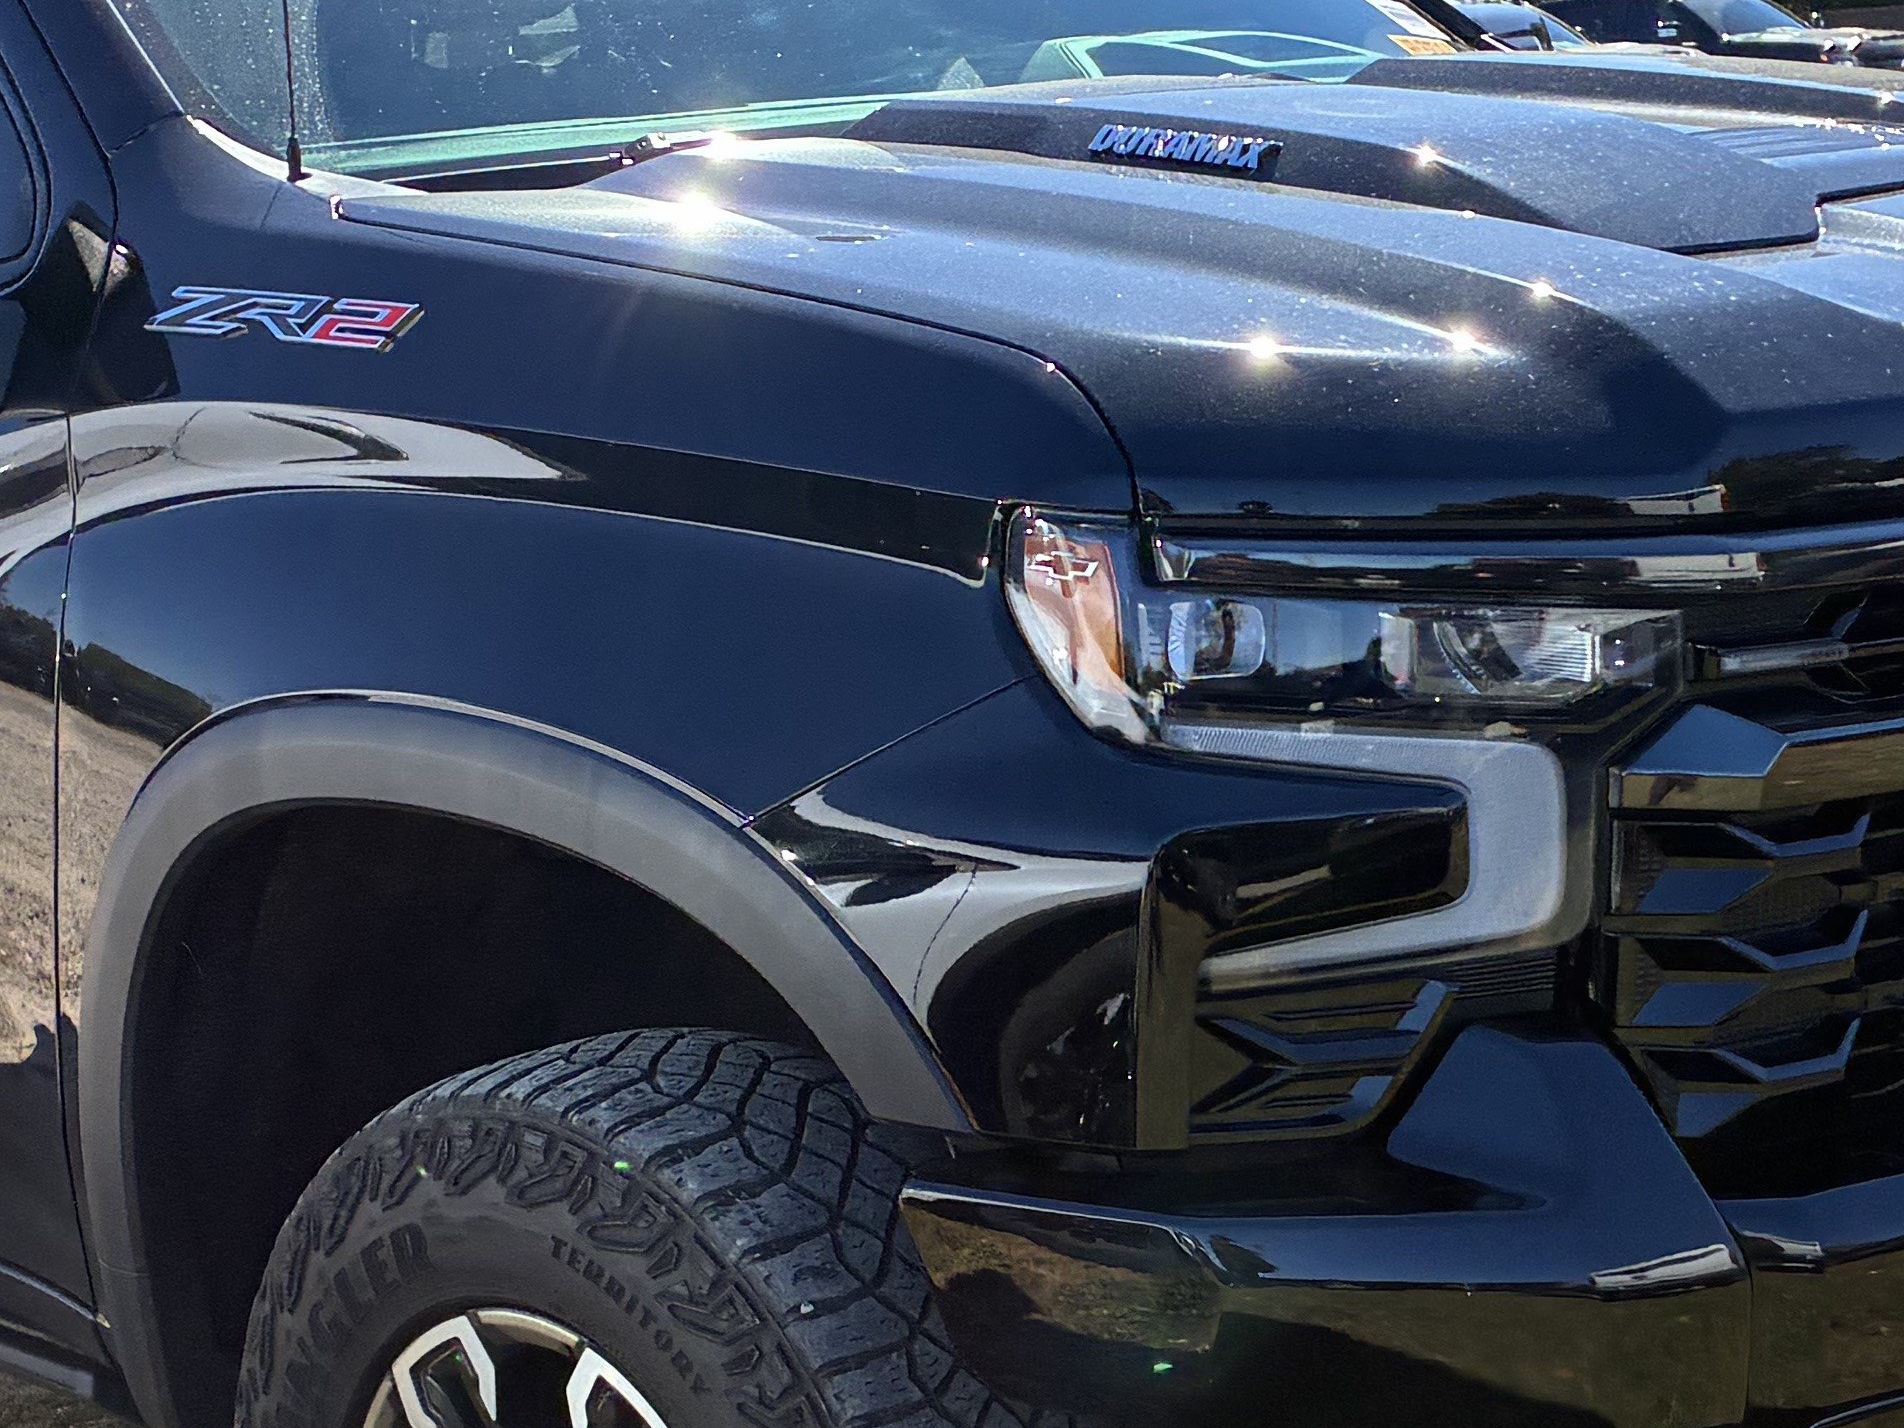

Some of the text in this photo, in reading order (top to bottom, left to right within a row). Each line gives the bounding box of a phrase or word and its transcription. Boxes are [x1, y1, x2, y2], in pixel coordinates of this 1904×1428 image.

[1087, 123, 1284, 171] DURAMAX
[144, 285, 426, 353] ZR2
[549, 1231, 712, 1406] TERRITORY
